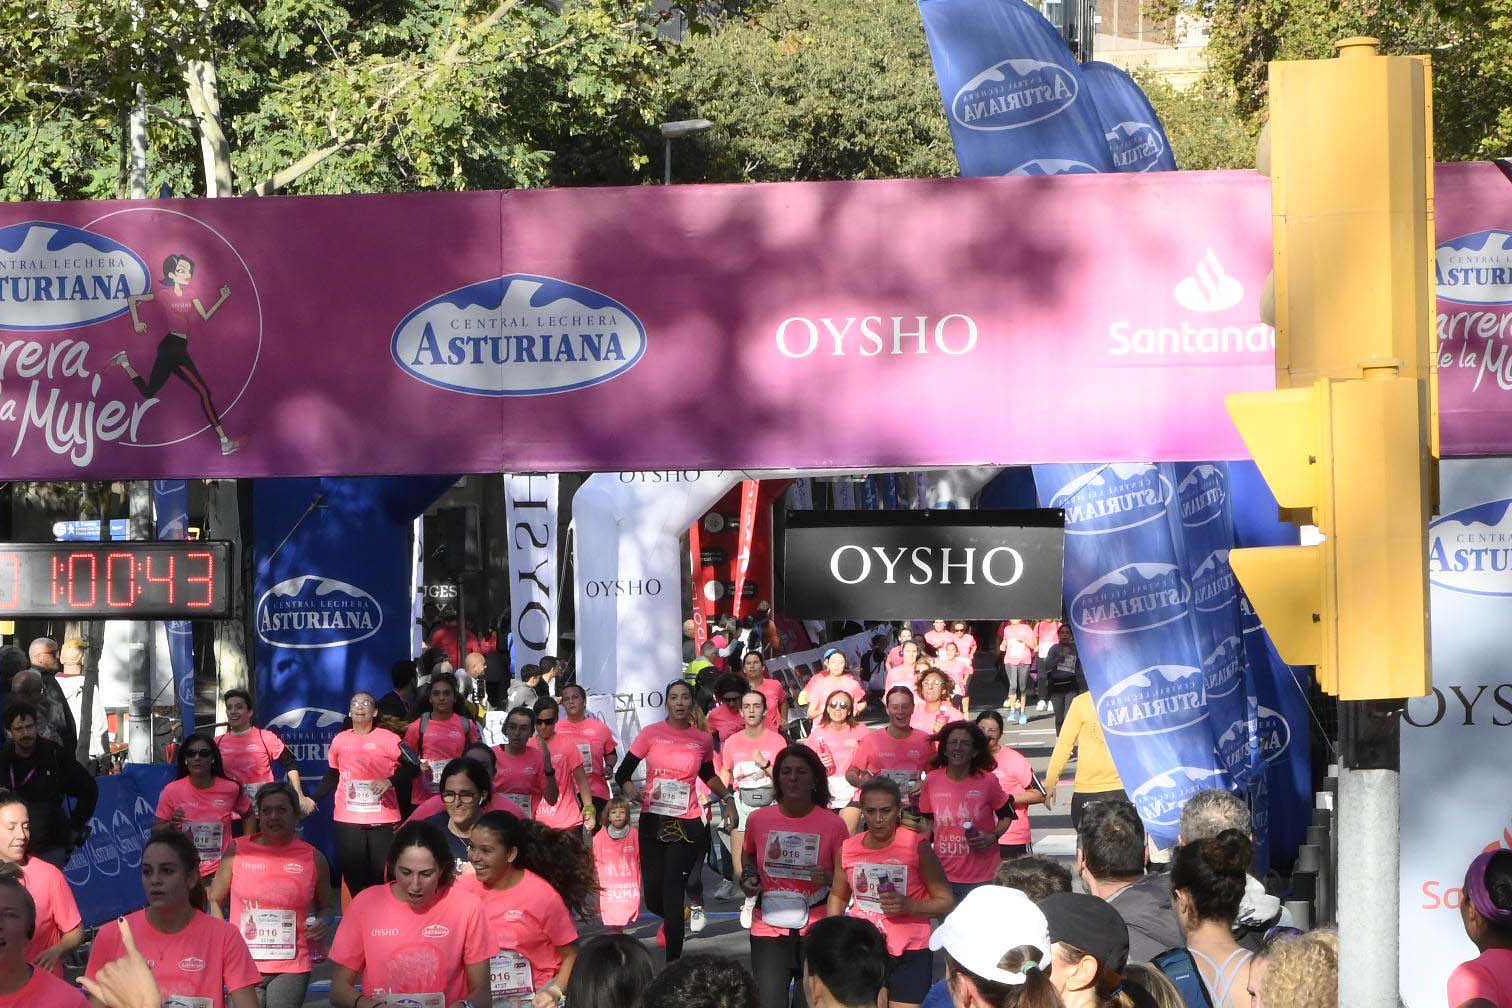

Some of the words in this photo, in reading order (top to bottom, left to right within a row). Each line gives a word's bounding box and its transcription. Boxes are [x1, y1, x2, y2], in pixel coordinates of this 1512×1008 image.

[54, 258, 126, 270] LECHERA
[450, 315, 528, 330] CENTRAL
[537, 313, 618, 328] LECHERA
[410, 321, 627, 366] ASTURIANA
[775, 313, 979, 359] OYSHO
[11, 375, 160, 468] Mujer
[829, 544, 1025, 587] OYSHO
[585, 578, 662, 598] OYSHO
[260, 603, 373, 632] ASTURIANA
[782, 850, 800, 859] 016
[258, 929, 278, 937] 016
[489, 972, 511, 982] 016
